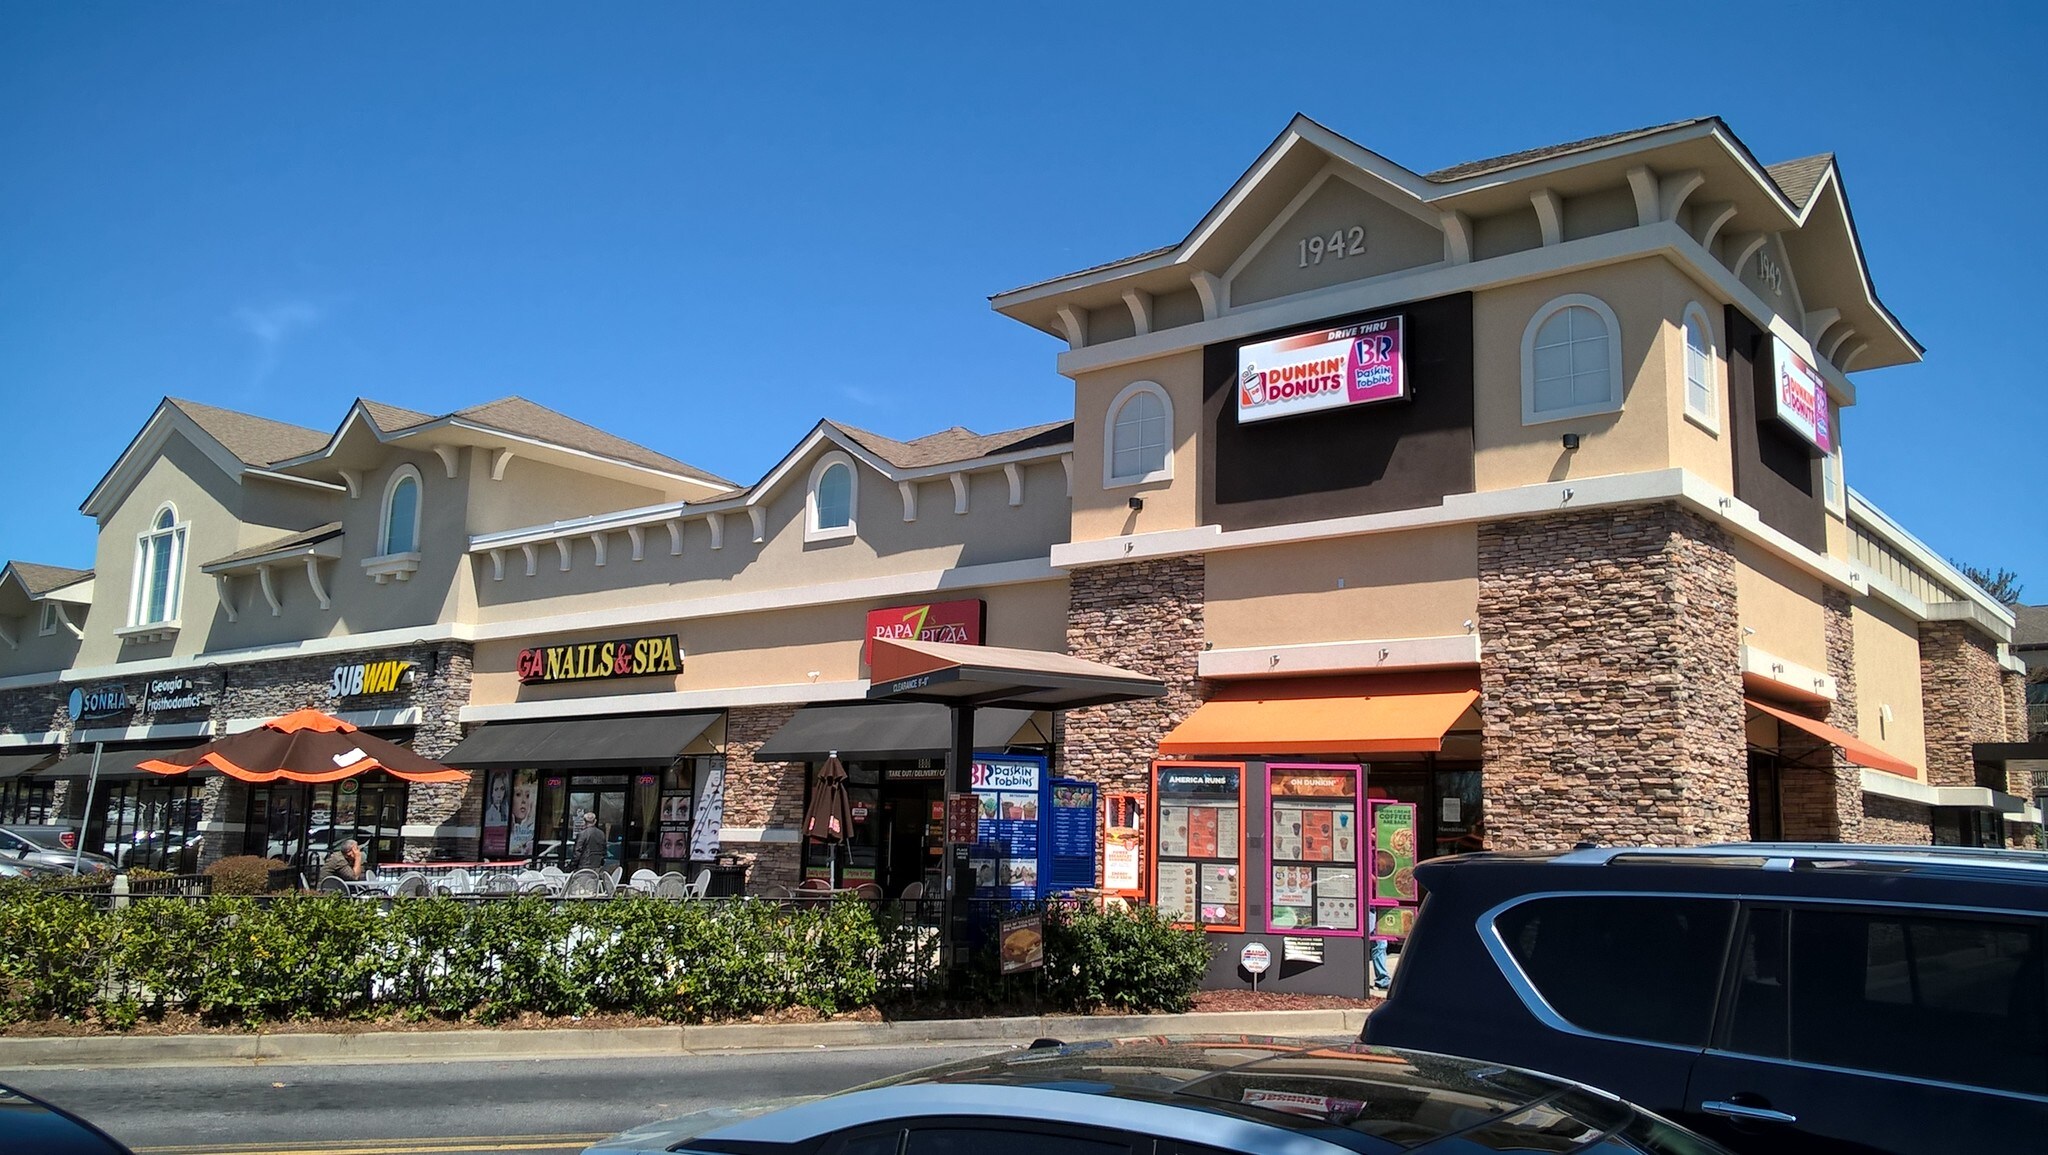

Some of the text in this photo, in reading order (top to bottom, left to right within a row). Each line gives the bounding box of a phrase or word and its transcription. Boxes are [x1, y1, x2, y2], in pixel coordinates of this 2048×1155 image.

[1298, 225, 1366, 268] 1942
[1758, 251, 1783, 296] 1942
[1327, 321, 1388, 341] DRIVE THRU
[1356, 337, 1392, 365] BR
[1269, 356, 1345, 384] DUNKIN'
[1356, 366, 1391, 378] baskin
[1269, 374, 1342, 400] DONUTS
[1357, 375, 1392, 388] robbins
[875, 623, 914, 639] PAPA
[517, 648, 543, 677] GA
[151, 676, 183, 694] Georgia
[329, 660, 411, 698] SUBWAY
[893, 680, 918, 693] CLEARANCE
[84, 692, 126, 712] SONRIA
[147, 693, 201, 712] Prosthodontics
[995, 765, 1032, 776] baskin
[1169, 775, 1227, 785] AMERICA RUNS
[995, 775, 1033, 787] robbins
[1290, 778, 1303, 786] ON
